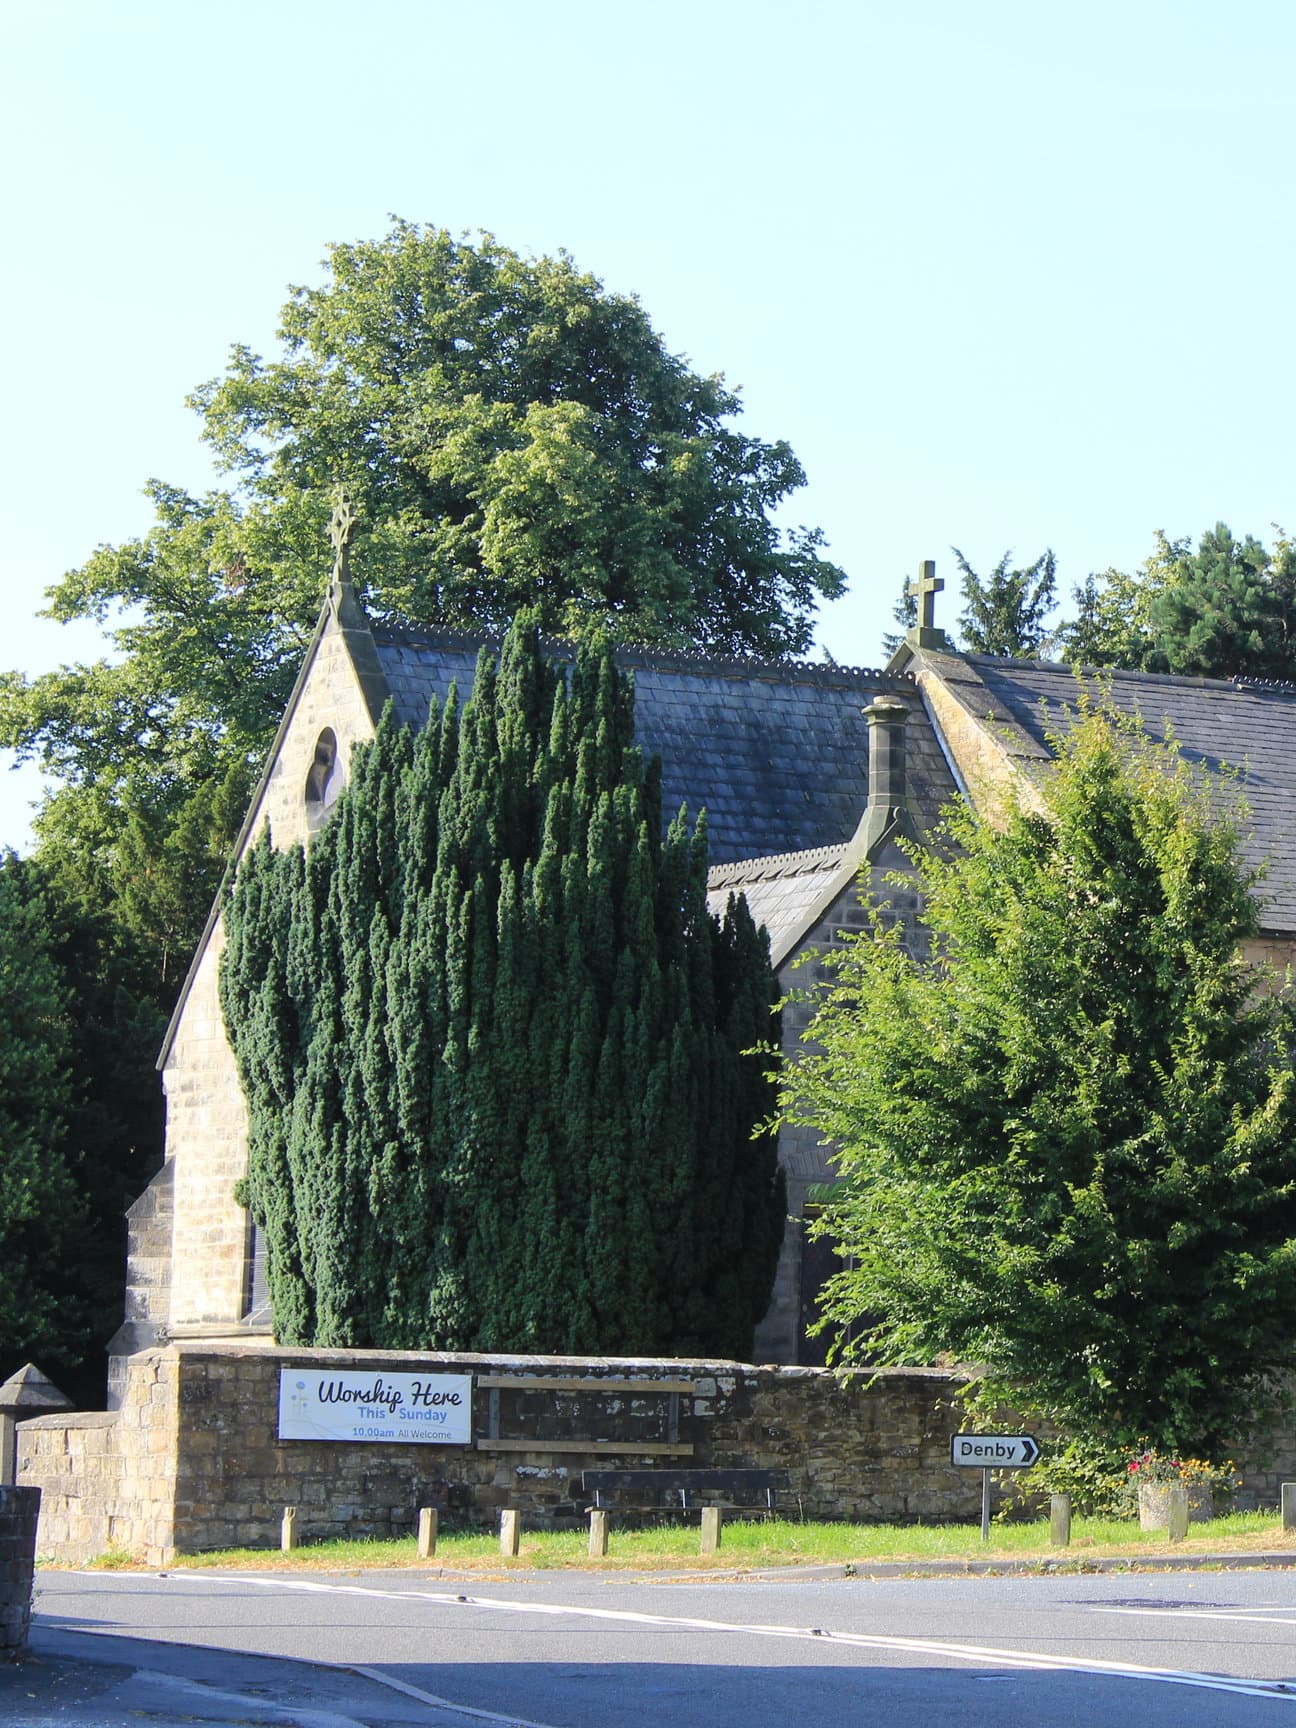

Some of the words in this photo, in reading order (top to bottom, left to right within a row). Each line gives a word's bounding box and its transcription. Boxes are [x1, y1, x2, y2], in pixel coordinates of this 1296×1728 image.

[318, 1379, 403, 1413] Worship
[411, 1381, 463, 1406] Here
[358, 1406, 386, 1419] This
[399, 1407, 448, 1423] Sunday
[398, 1429, 409, 1438] All
[411, 1429, 452, 1440] Welcome
[961, 1442, 1016, 1460] Denby
